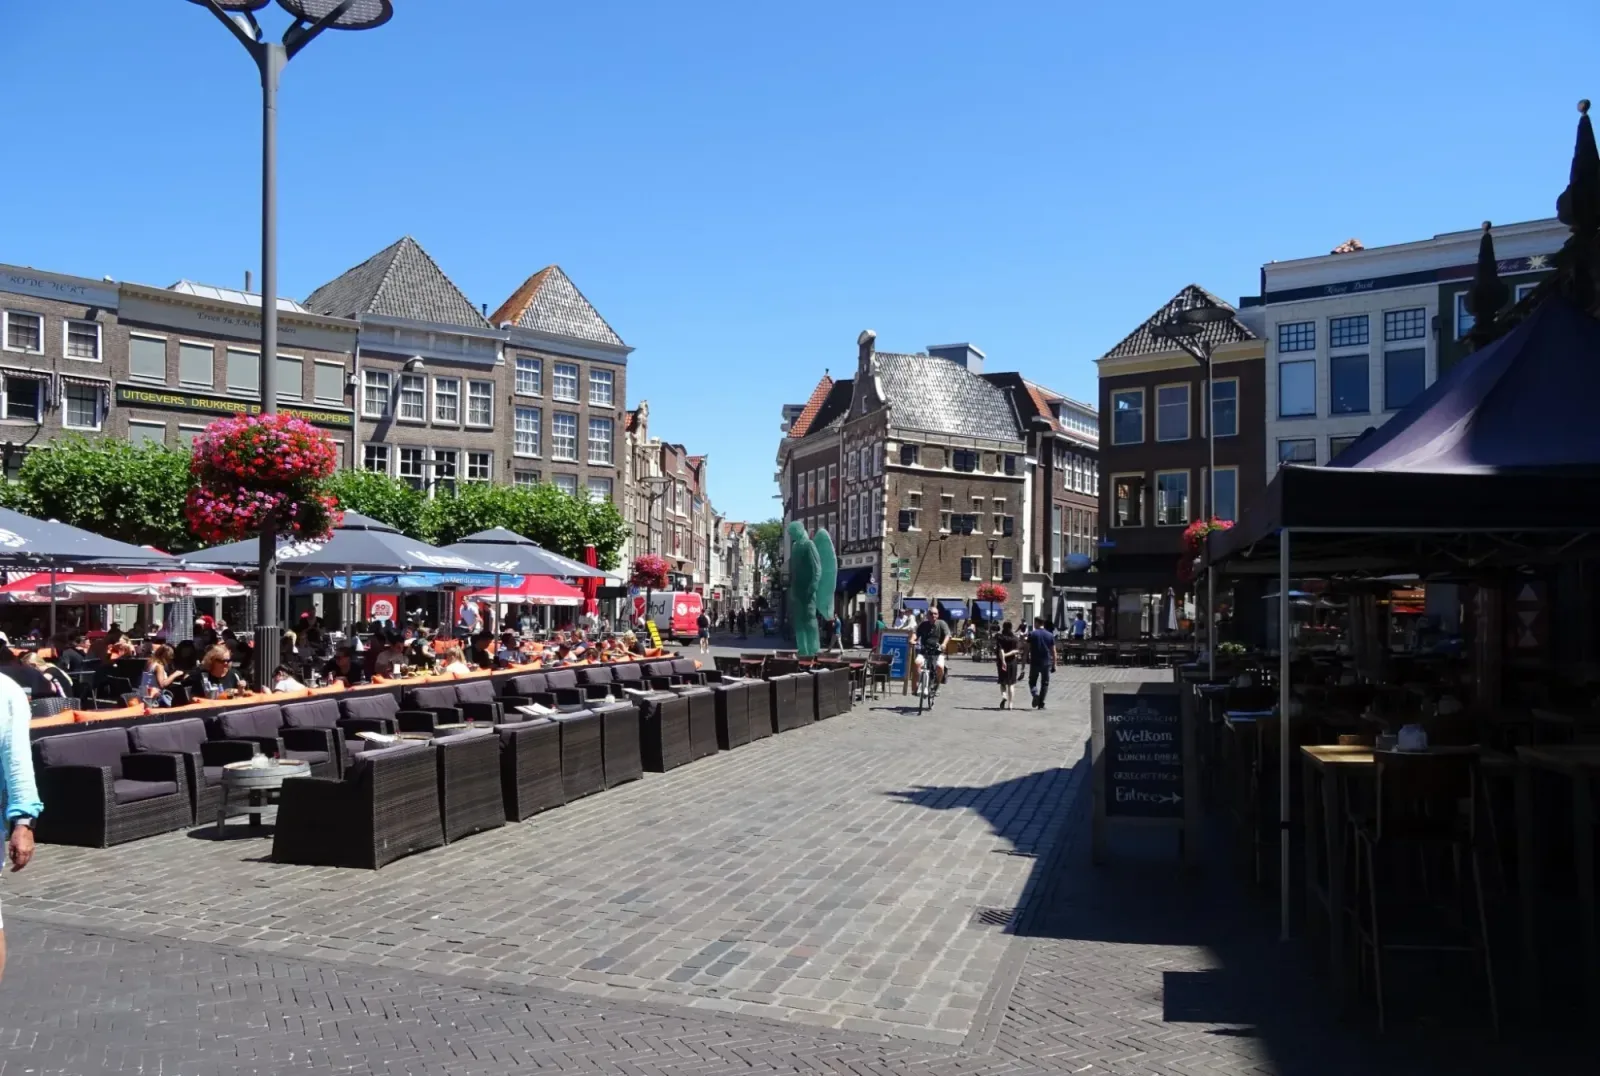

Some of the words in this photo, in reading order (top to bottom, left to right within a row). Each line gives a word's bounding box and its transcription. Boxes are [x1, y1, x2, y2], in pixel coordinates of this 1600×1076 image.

[122, 389, 187, 406] UITGEVERS,
[191, 398, 247, 412] DRUKKERS
[276, 407, 350, 424] OEKVERKOPERS
[1115, 729, 1173, 743] Welkom
